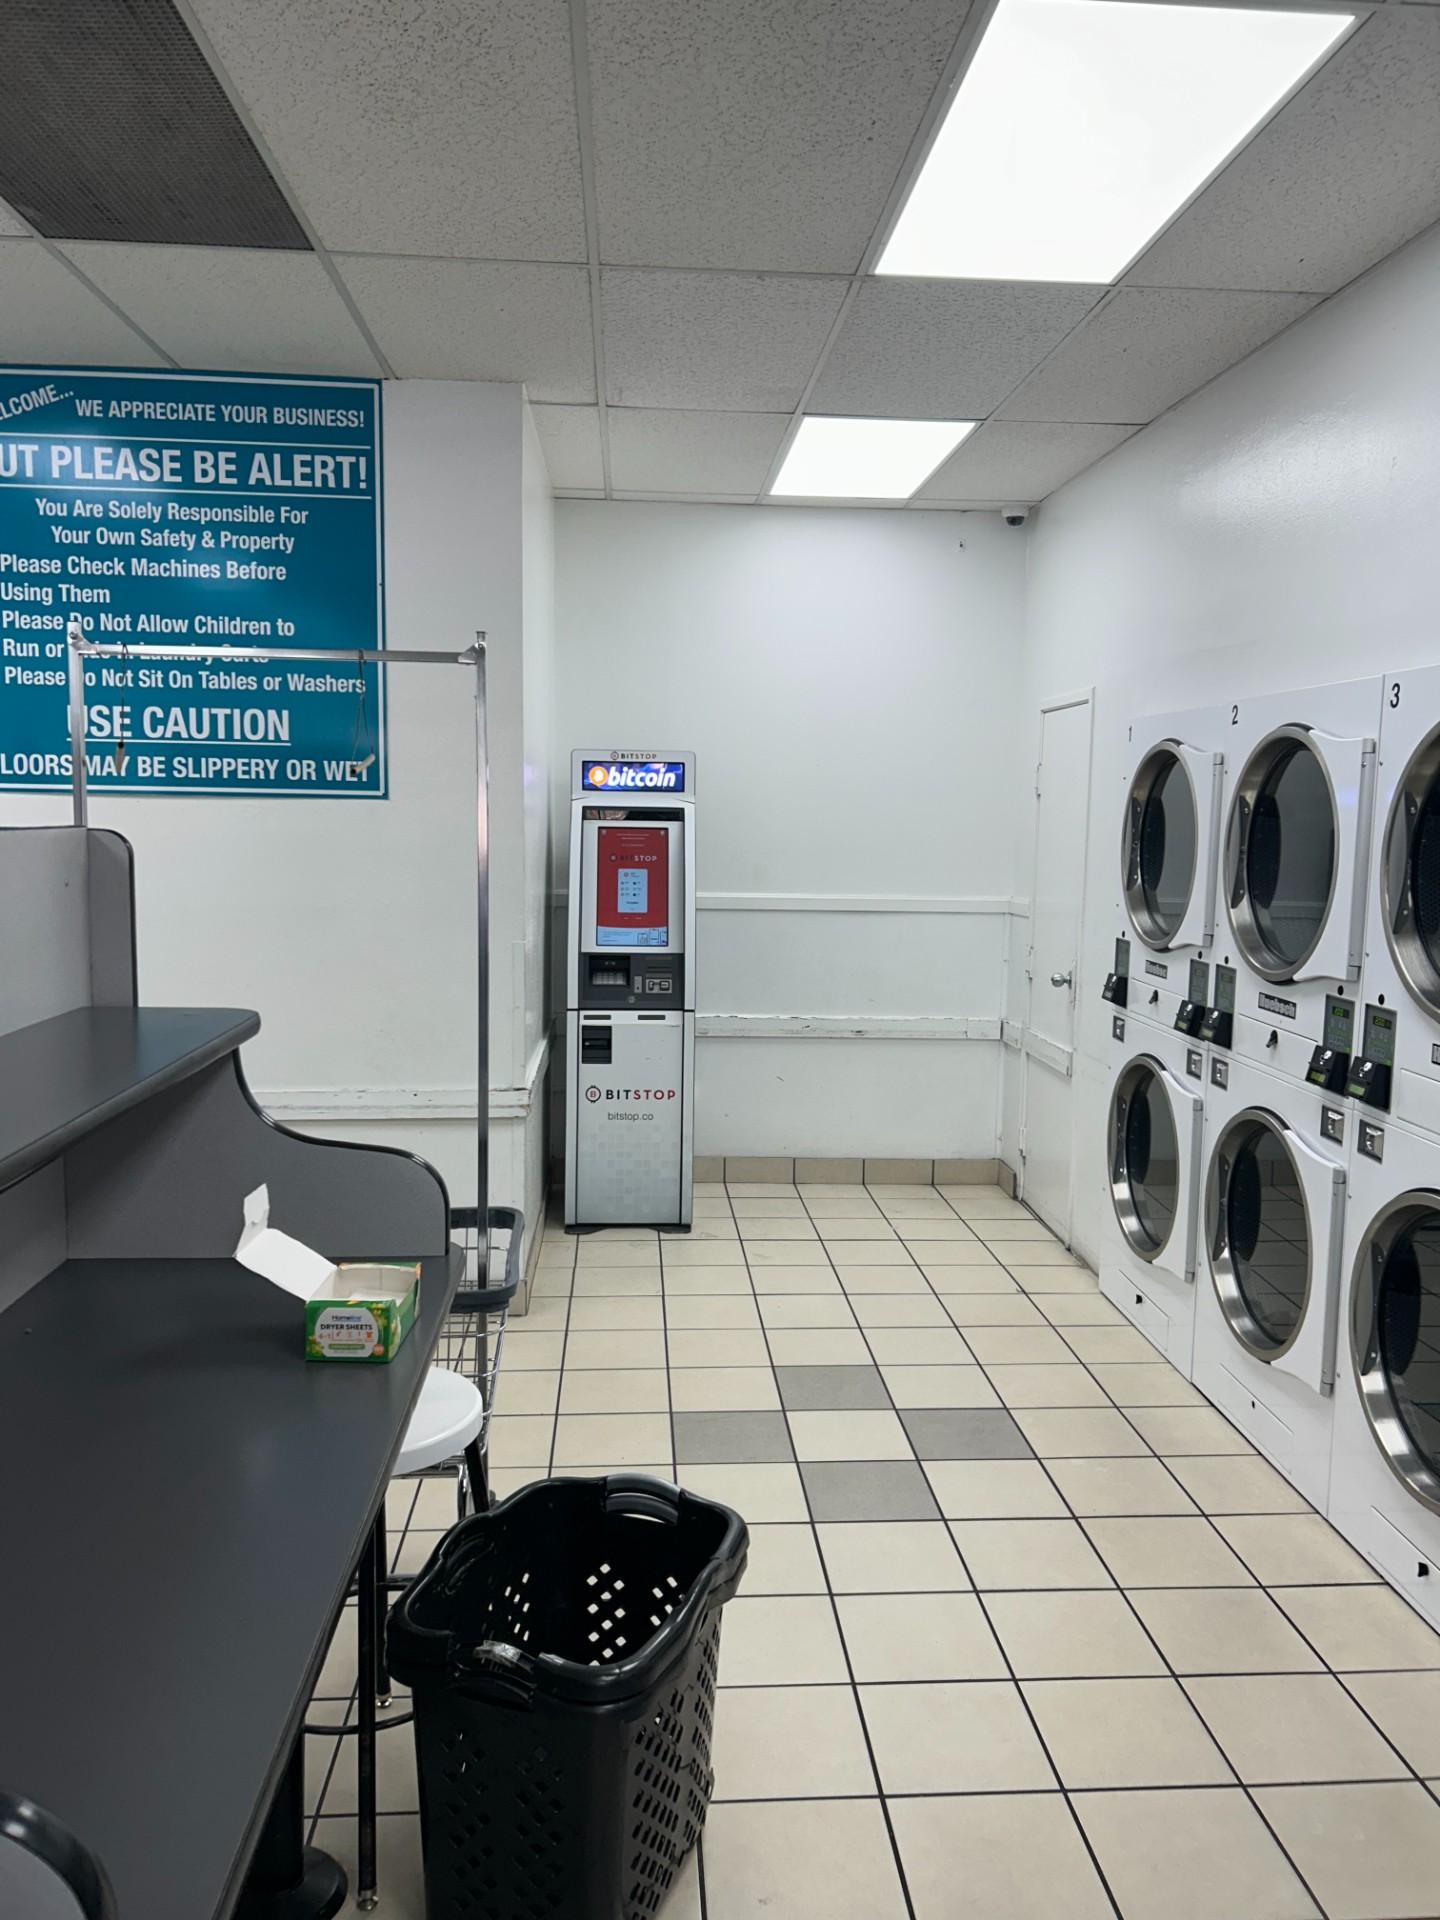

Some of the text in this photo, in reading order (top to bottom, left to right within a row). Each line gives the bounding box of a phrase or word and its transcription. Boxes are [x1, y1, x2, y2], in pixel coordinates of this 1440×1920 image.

[0, 384, 75, 420] LCOME...
[75, 399, 365, 427] WE APPRECIATE YOUR BUSINESS!
[50, 444, 182, 483] PLEASE
[193, 450, 239, 485] BE
[248, 452, 367, 489] ALERT!
[35, 498, 309, 525] You Are Solely Responsible For
[51, 526, 295, 554] Your Own Safety & Property
[0, 554, 287, 581] Please Check Machines Before
[0, 582, 111, 606] Using Them
[2, 610, 64, 630] Please
[100, 613, 132, 632] Not
[136, 613, 189, 634] Allow
[194, 615, 272, 635] Children
[277, 619, 295, 636] to
[3, 638, 39, 657] Run
[45, 643, 64, 658] or
[4, 666, 66, 685] Please
[101, 668, 134, 687] Not
[138, 669, 164, 688] Sit
[168, 670, 193, 688] On
[198, 671, 258, 690] Tables
[263, 676, 282, 691] or
[287, 673, 366, 693] Washers
[1389, 682, 1401, 709] 3
[143, 705, 290, 741] CAUTION
[1231, 704, 1239, 725] 2
[1127, 725, 1132, 742] 1
[137, 756, 166, 779] BE
[172, 756, 279, 779] SLIPPERY
[286, 759, 317, 781] OR
[607, 765, 676, 788] bitcoin
[605, 1089, 676, 1100] BITSTOP
[607, 1112, 654, 1122] bitstop.co
